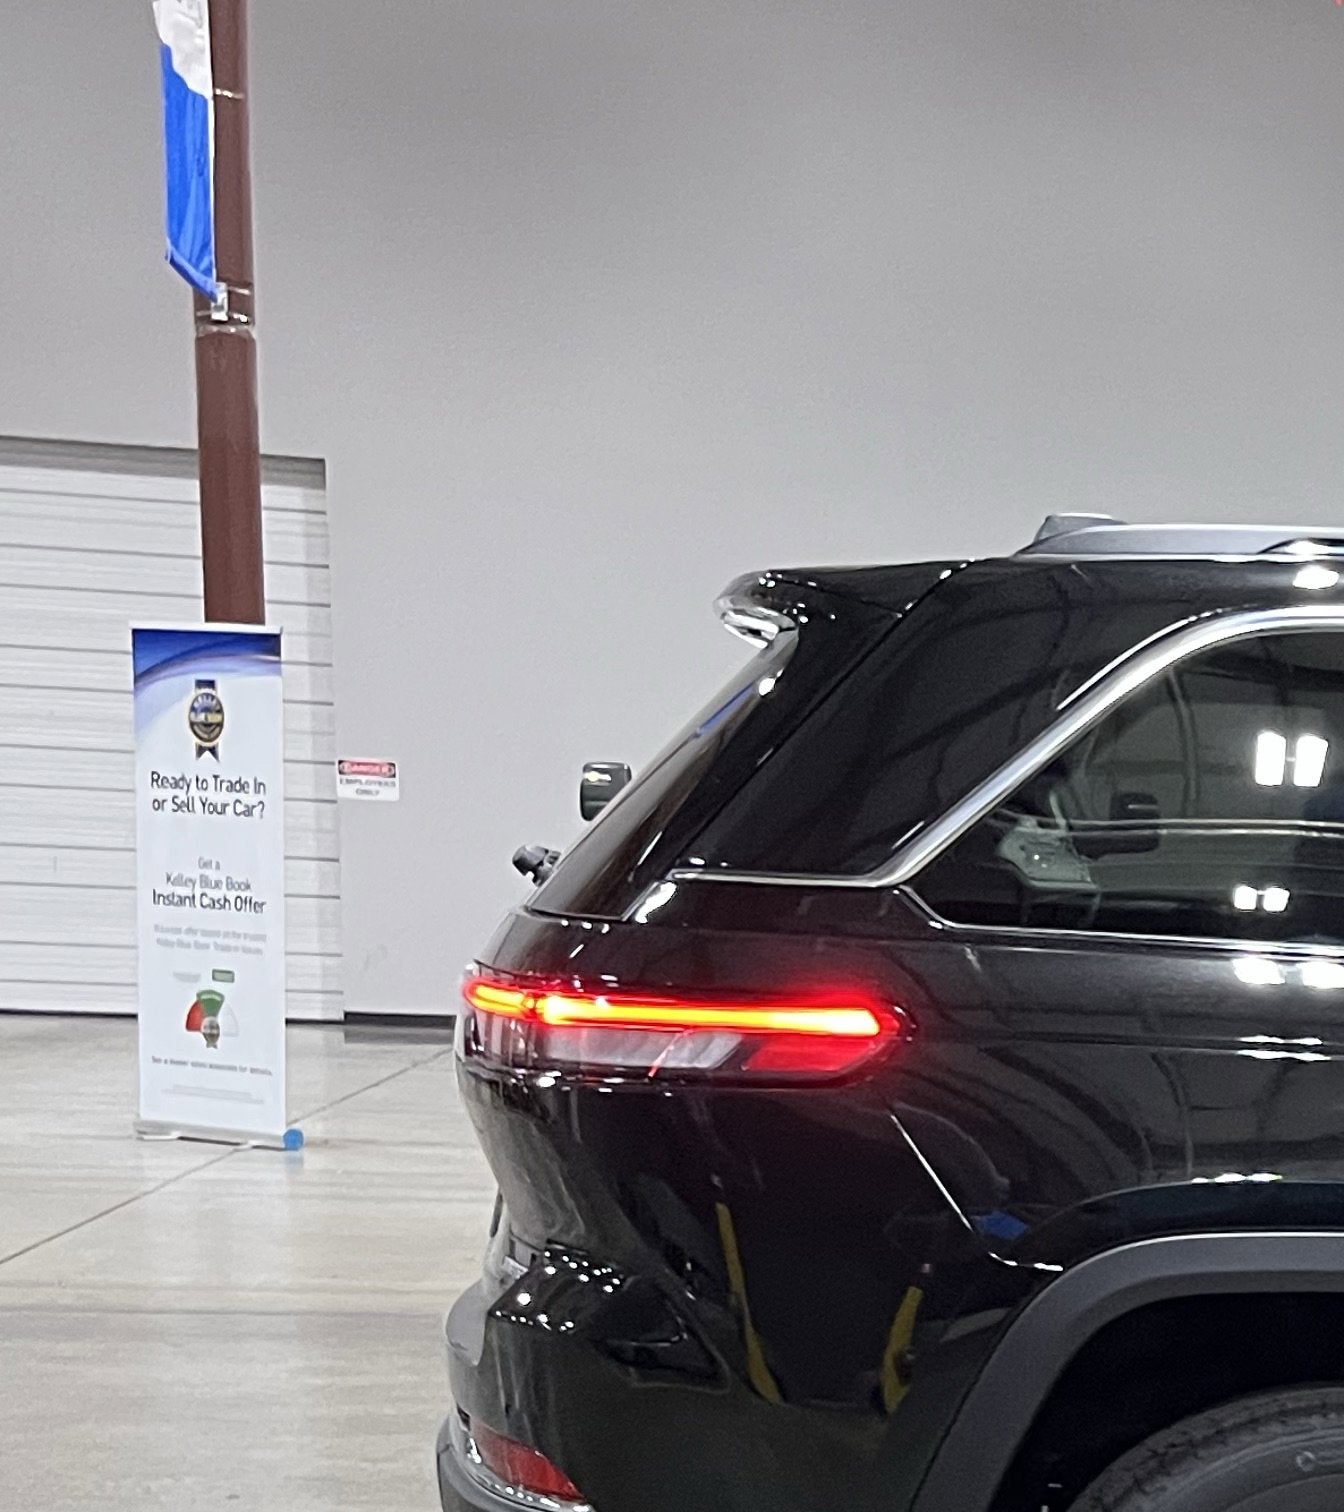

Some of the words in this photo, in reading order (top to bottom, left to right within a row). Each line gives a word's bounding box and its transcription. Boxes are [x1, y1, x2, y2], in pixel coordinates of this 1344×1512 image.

[151, 771, 192, 795] Ready
[196, 774, 208, 791] to
[213, 774, 250, 794] Trade
[254, 776, 266, 795] In
[152, 798, 167, 811] or
[172, 795, 196, 814] Sell
[200, 798, 230, 815] Your
[233, 799, 265, 819] Car?
[198, 856, 213, 870] Get
[215, 861, 221, 871] a
[166, 872, 196, 892] Kelley
[200, 874, 223, 890] Blue
[226, 876, 251, 892] Book
[152, 889, 197, 908] Instant
[200, 892, 231, 911] Cash
[234, 895, 267, 914] Offer
